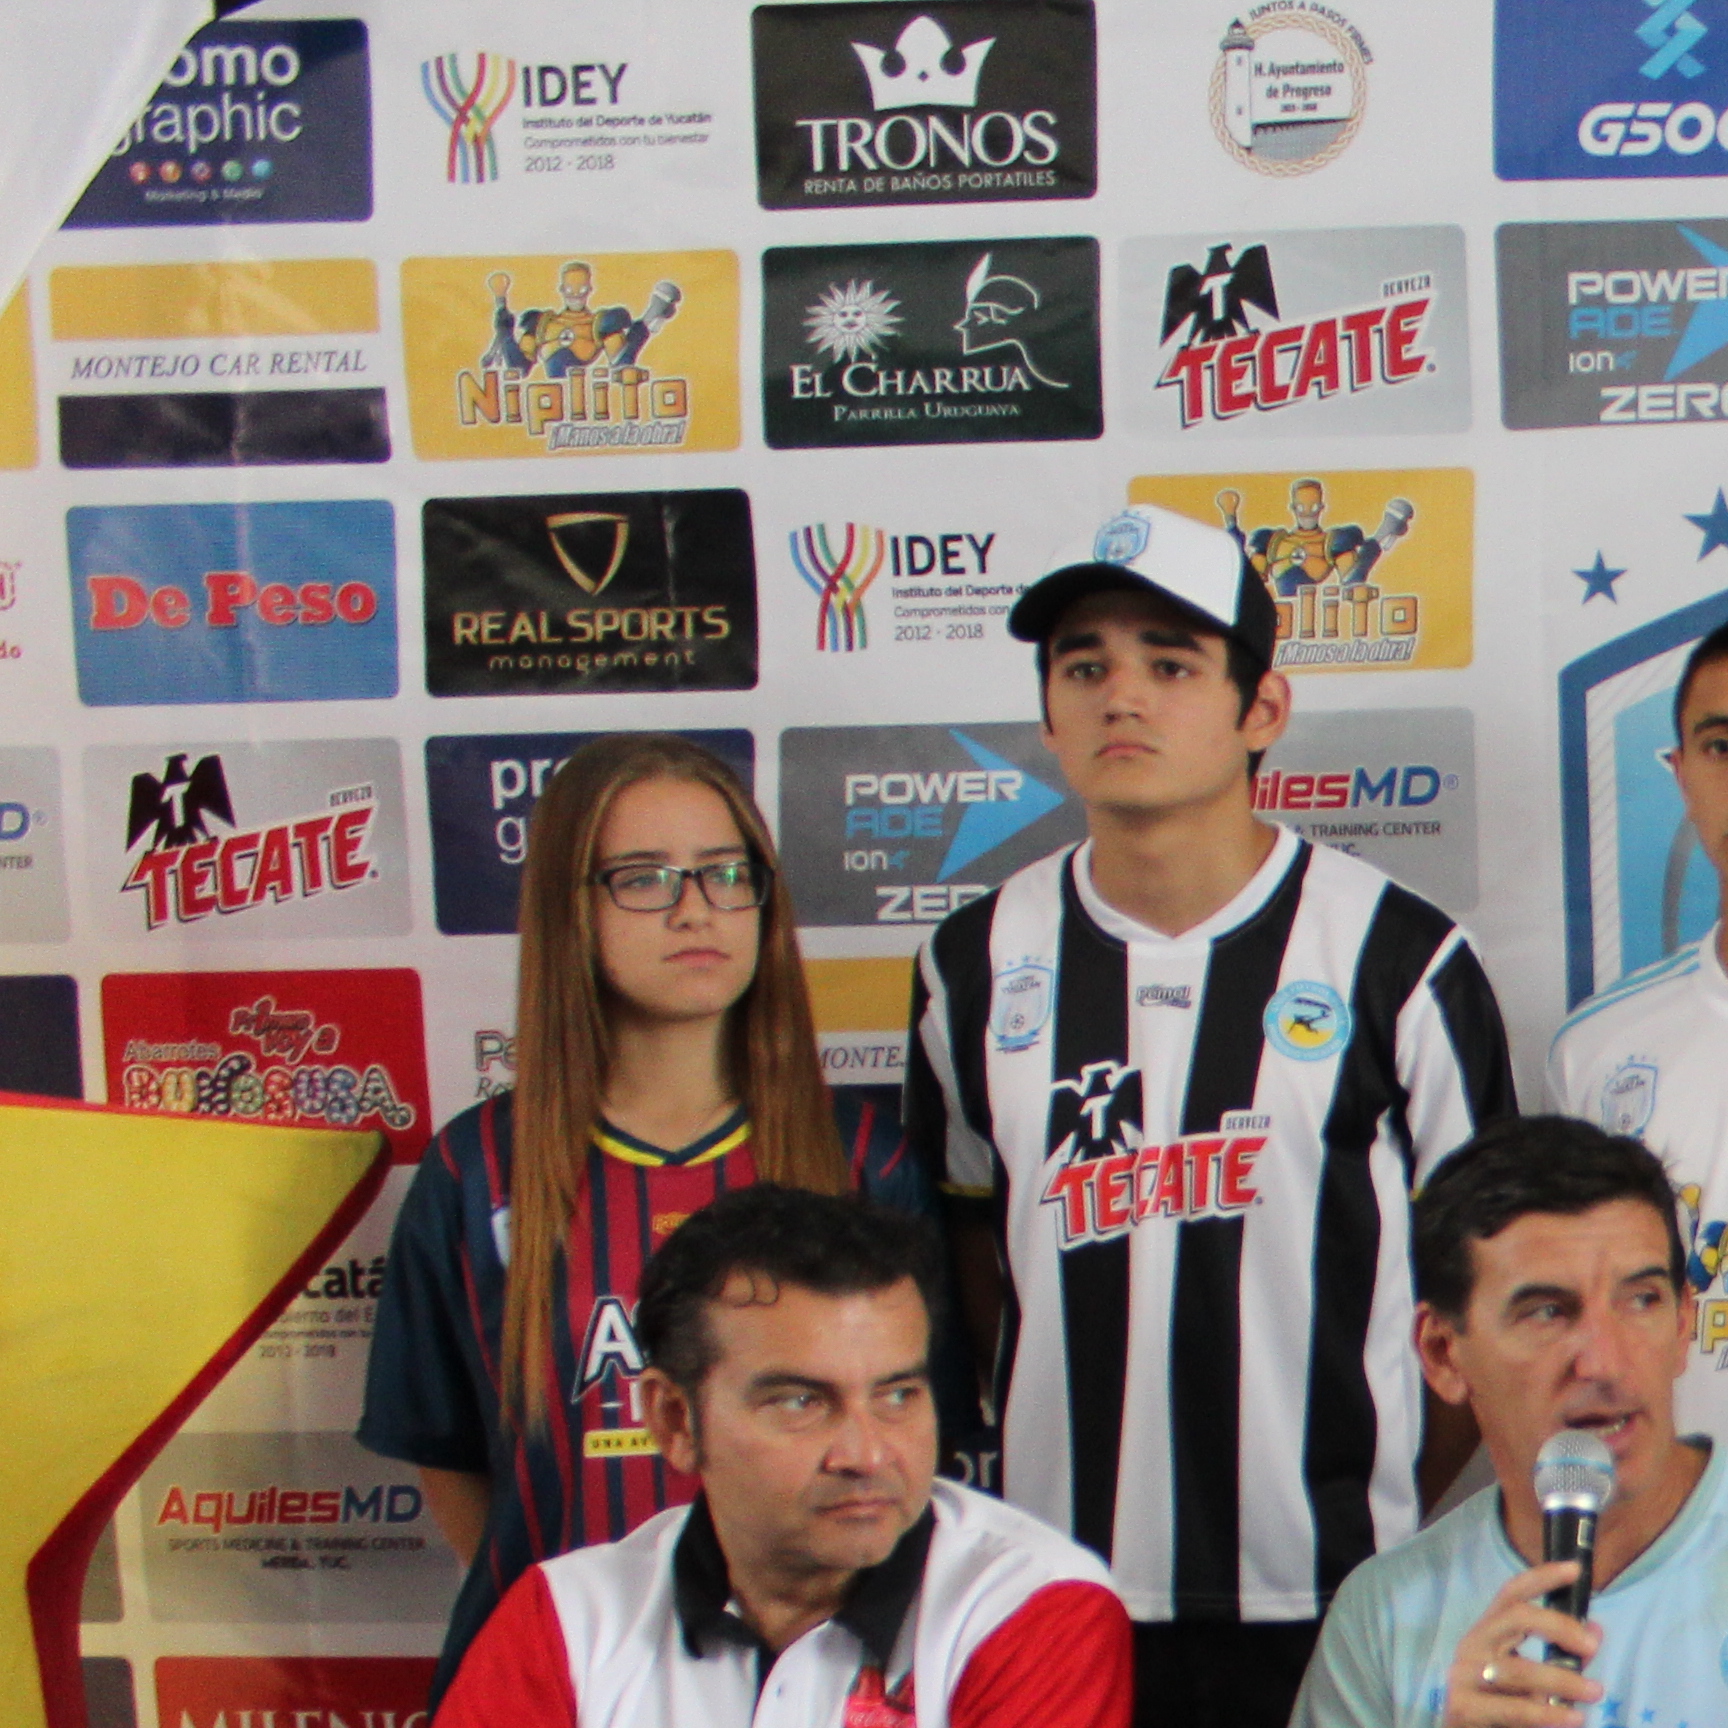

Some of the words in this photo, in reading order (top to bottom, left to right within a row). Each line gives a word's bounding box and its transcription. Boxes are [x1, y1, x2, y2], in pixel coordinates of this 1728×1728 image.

[521, 62, 629, 108] IDEY
[1267, 59, 1345, 80] Ayuntamiento
[1265, 84, 1280, 100] de
[1281, 82, 1333, 101] Progreso
[110, 90, 303, 157] raphic
[521, 116, 574, 130] Instituto
[575, 115, 594, 128] del
[595, 114, 646, 130] Deporte
[647, 113, 664, 126] de
[618, 134, 642, 147] con
[795, 110, 1060, 174] TRONOS
[524, 156, 563, 173] 2012
[576, 154, 616, 172] 2018
[803, 178, 859, 195] RENTA
[863, 176, 887, 194] DE
[890, 170, 952, 192] BAÑOS
[957, 170, 1057, 189] PORTATILES
[1568, 306, 1675, 341] ADE
[71, 354, 201, 381] MONTEJO
[208, 352, 263, 378] CAR
[268, 348, 369, 376] RENTAL
[1155, 297, 1437, 431] TECATE
[890, 532, 996, 577] IDEY
[87, 574, 191, 631] De
[205, 571, 379, 626] Peso
[892, 586, 943, 599] Instituto
[943, 585, 963, 596] del
[965, 584, 1013, 599] Deporte
[894, 605, 986, 619] Comprometidos
[987, 604, 1010, 616] con
[894, 624, 932, 642] 2012
[945, 623, 984, 639] 2018
[490, 652, 695, 673] management
[844, 769, 1023, 806] POWER
[843, 805, 944, 840] ADE
[1310, 823, 1380, 838] TRAINING
[1382, 820, 1442, 836] CENTER
[121, 806, 381, 931] TECATE
[1039, 1134, 1270, 1251] TECATE
[158, 1483, 423, 1535] AquilesMD
